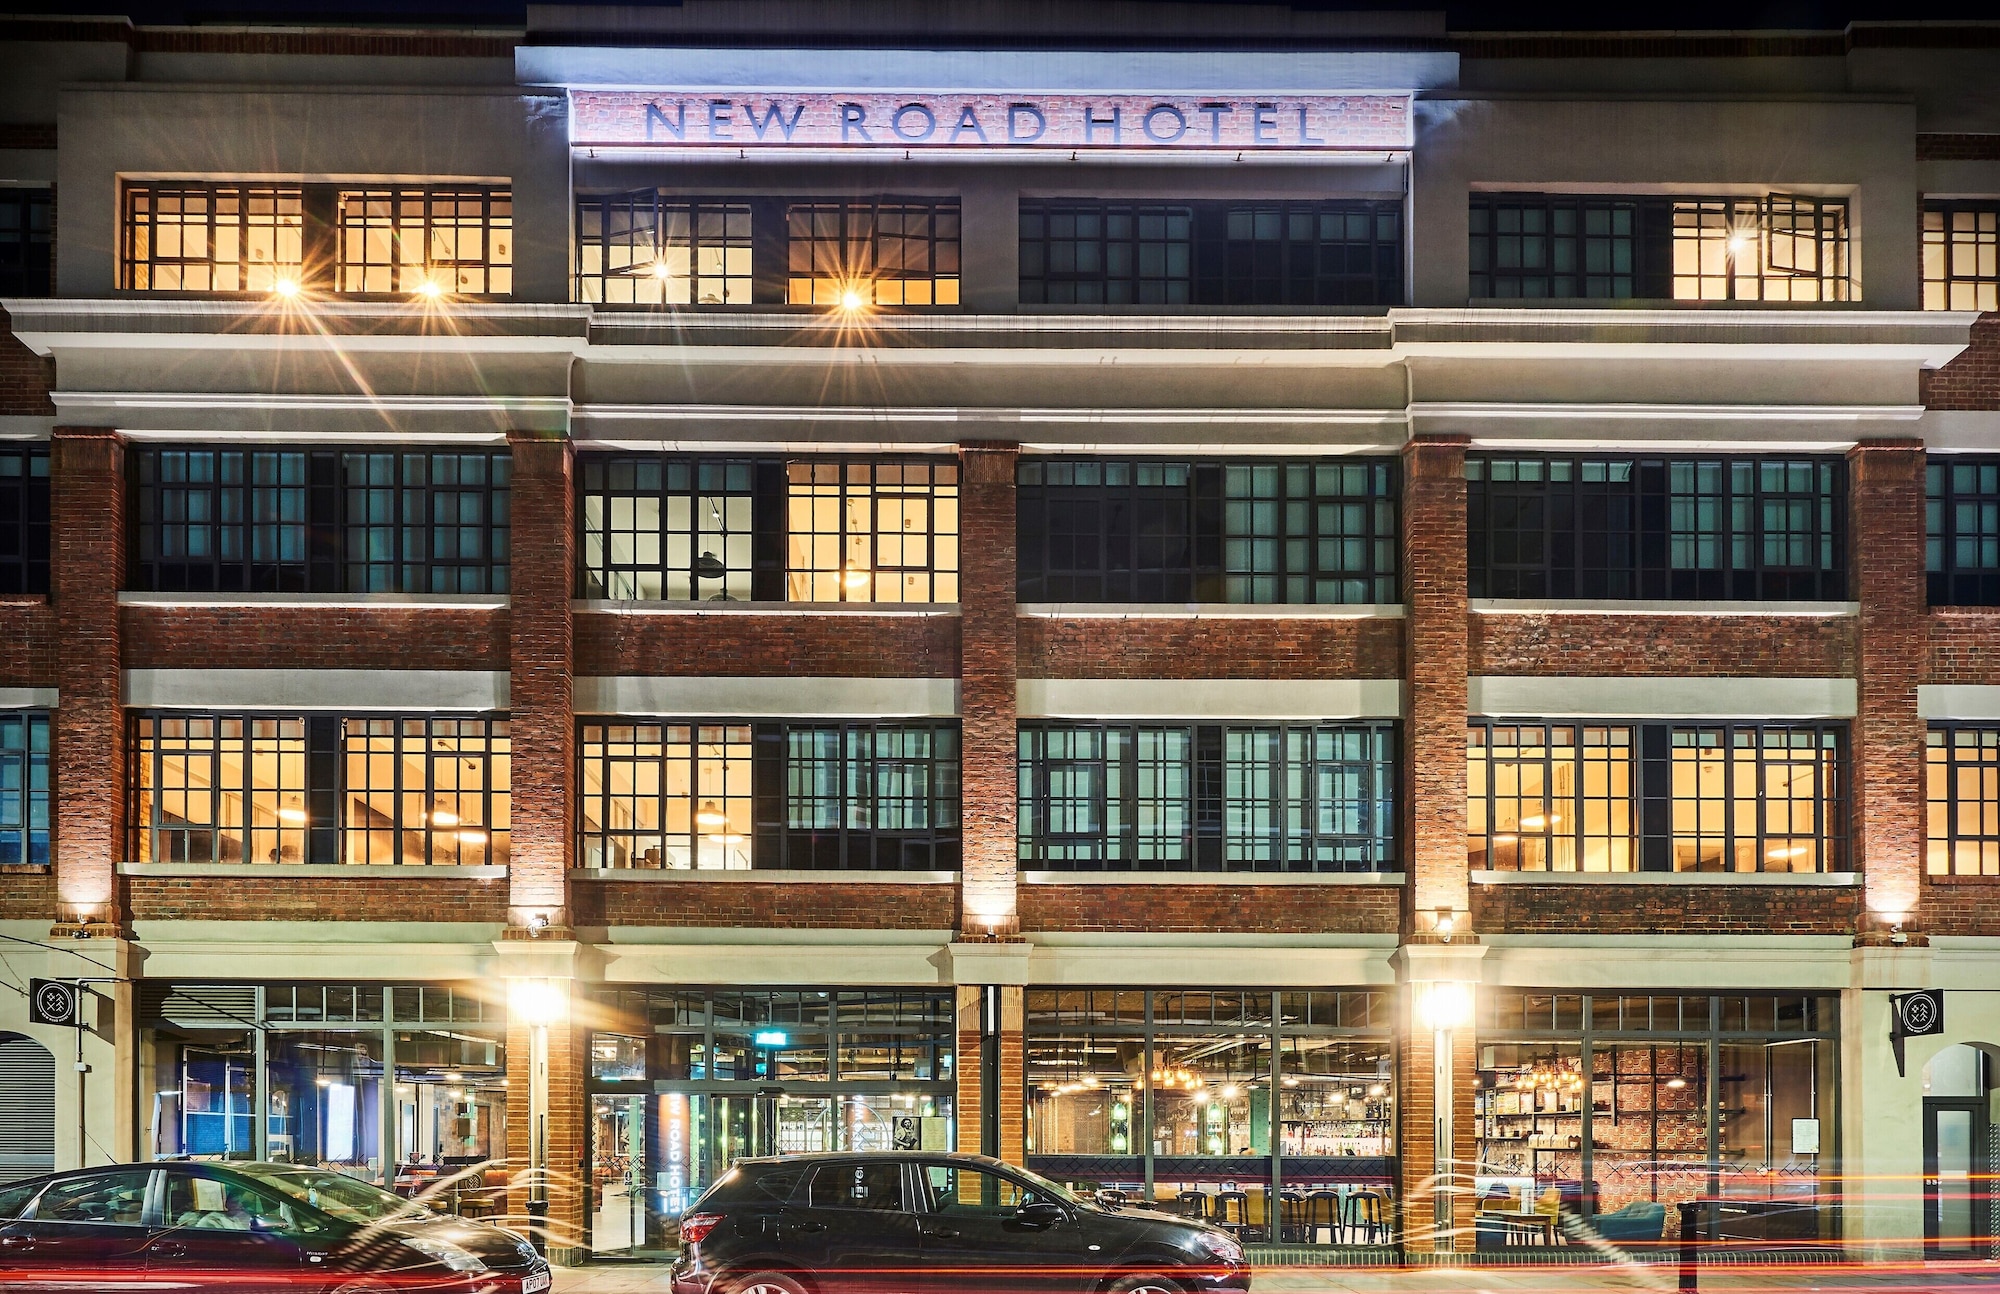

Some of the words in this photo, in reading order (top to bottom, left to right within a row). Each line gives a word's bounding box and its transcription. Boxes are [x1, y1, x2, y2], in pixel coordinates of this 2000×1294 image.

[646, 102, 805, 141] NEW
[841, 102, 1046, 142] ROAD
[1086, 104, 1324, 144] HOTEL
[669, 1119, 682, 1162] ROAD
